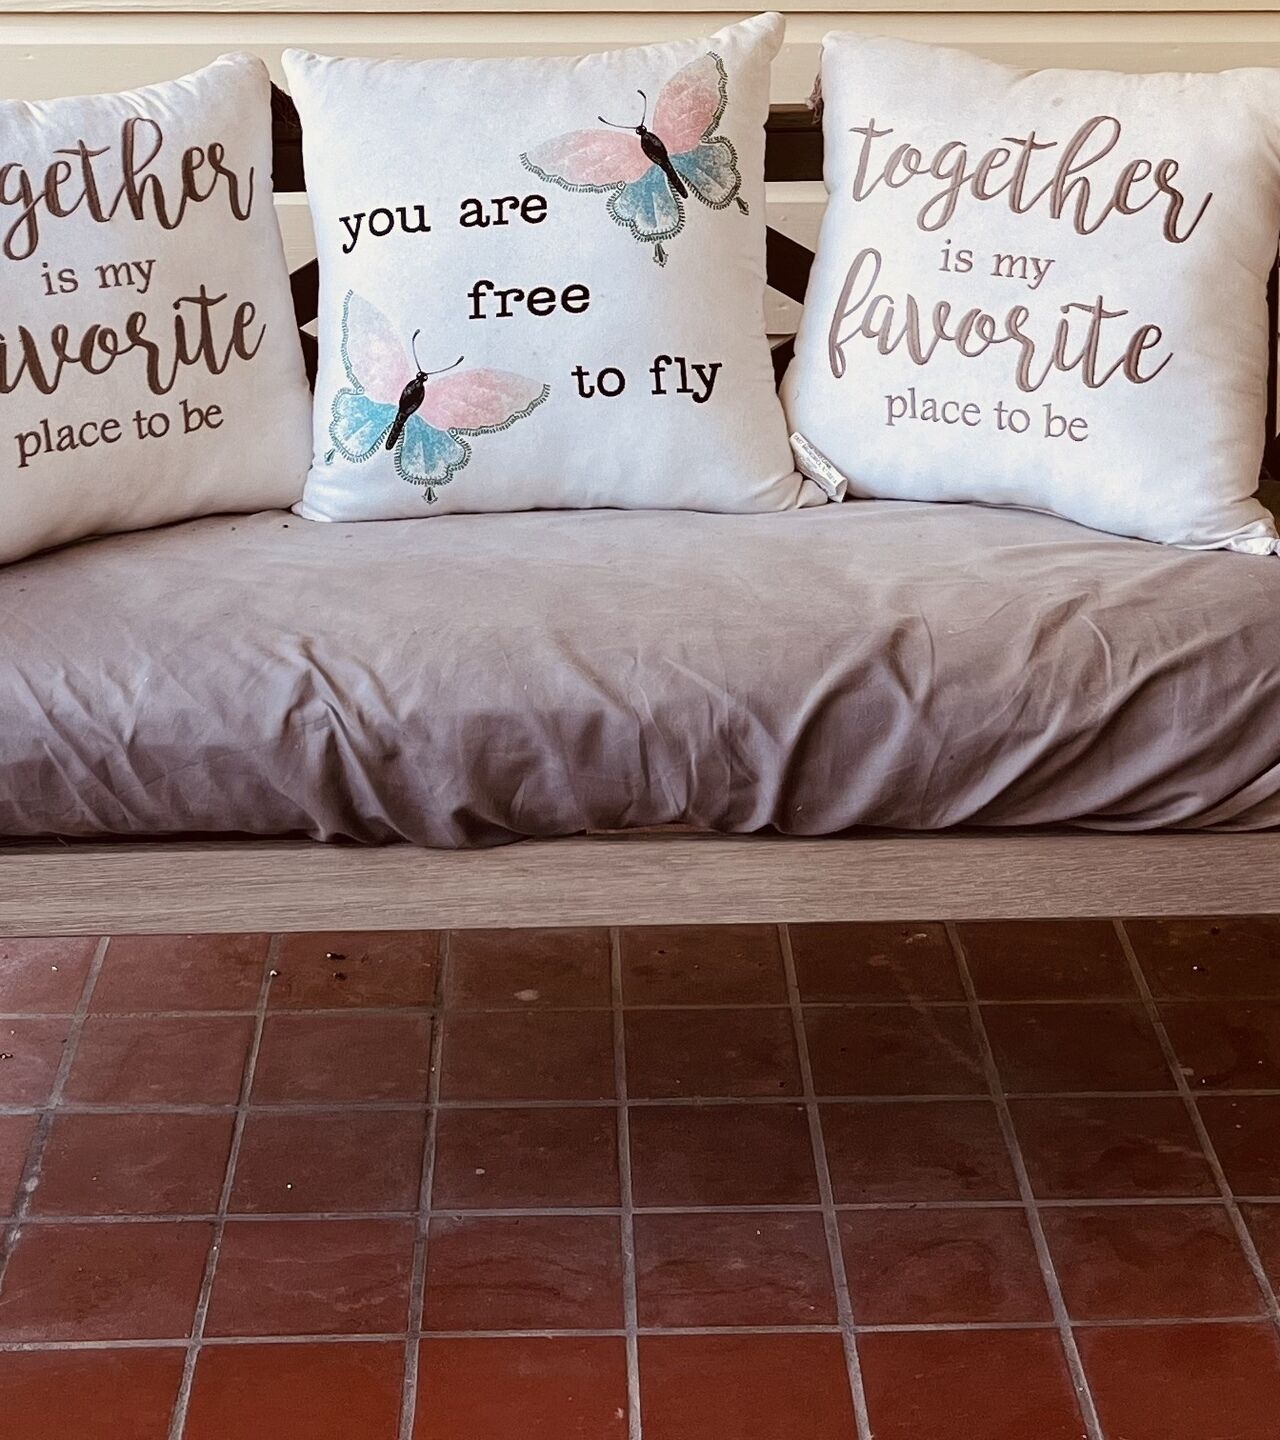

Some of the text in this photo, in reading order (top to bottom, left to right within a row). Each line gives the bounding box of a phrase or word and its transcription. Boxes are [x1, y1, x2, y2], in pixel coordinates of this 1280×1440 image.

[849, 115, 1213, 244] together
[339, 193, 549, 254] you are
[42, 259, 157, 296] is my
[938, 239, 1055, 290] is my
[467, 279, 591, 320] free
[828, 247, 1174, 393] favorite
[570, 355, 723, 404] to fly
[15, 399, 225, 469] place to be
[884, 386, 1090, 443] place to be
